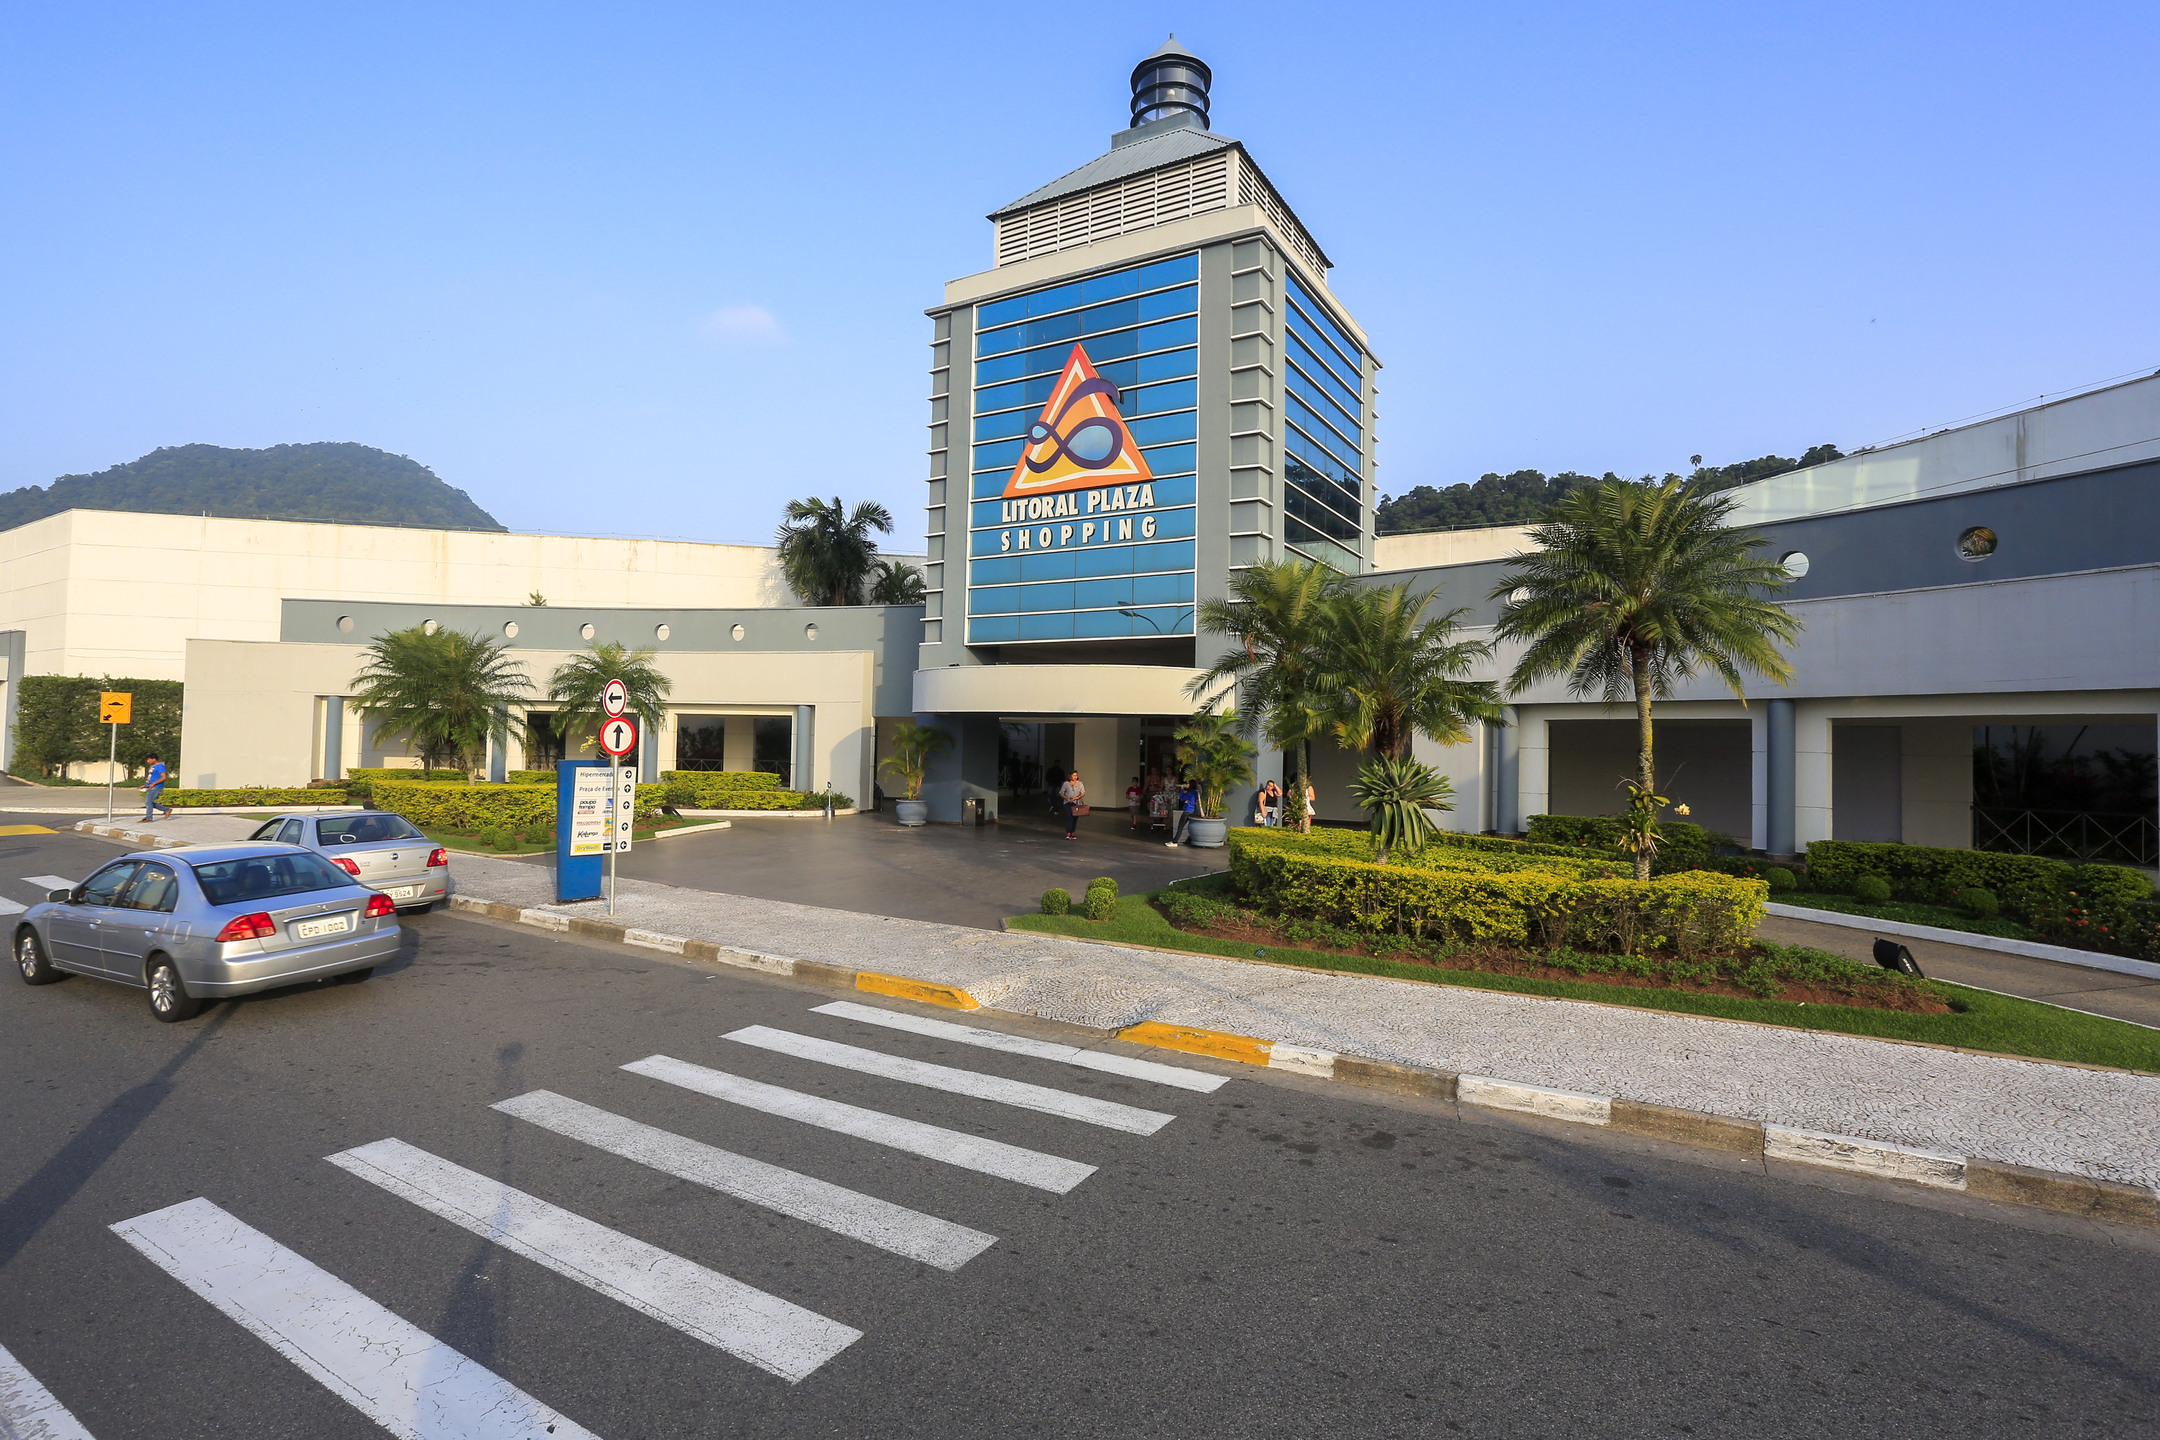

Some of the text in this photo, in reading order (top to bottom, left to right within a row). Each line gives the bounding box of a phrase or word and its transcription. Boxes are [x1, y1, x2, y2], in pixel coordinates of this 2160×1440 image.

[1002, 484, 1155, 523] LITORAL PLAZA
[1001, 516, 1156, 552] SHOPPING
